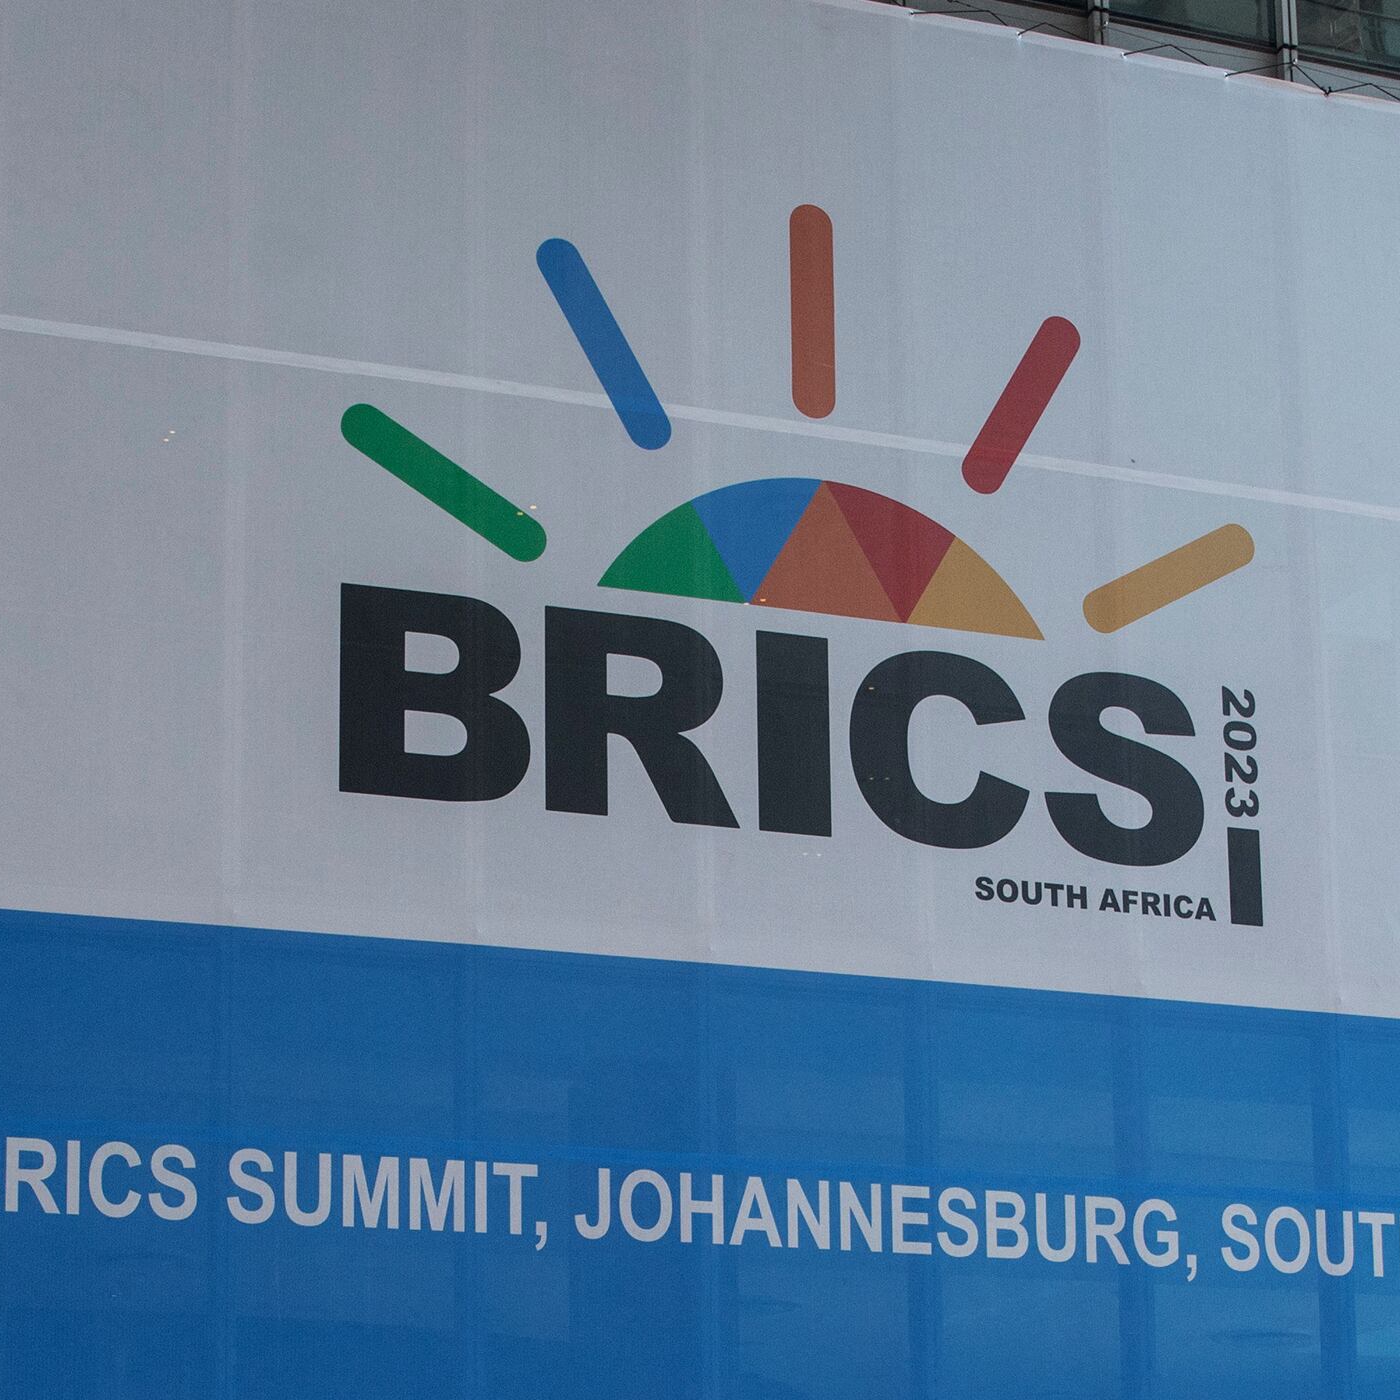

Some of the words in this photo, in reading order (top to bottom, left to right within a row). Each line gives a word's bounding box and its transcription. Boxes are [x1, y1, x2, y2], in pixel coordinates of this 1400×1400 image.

[339, 582, 1205, 867] BRICS
[1221, 685, 1260, 818] 2023
[975, 876, 1088, 909] SOUTH
[1099, 888, 1217, 921] AFRICA
[225, 1147, 550, 1250] SUMMIT,
[573, 1166, 1197, 1282] JOHANNESBURG,
